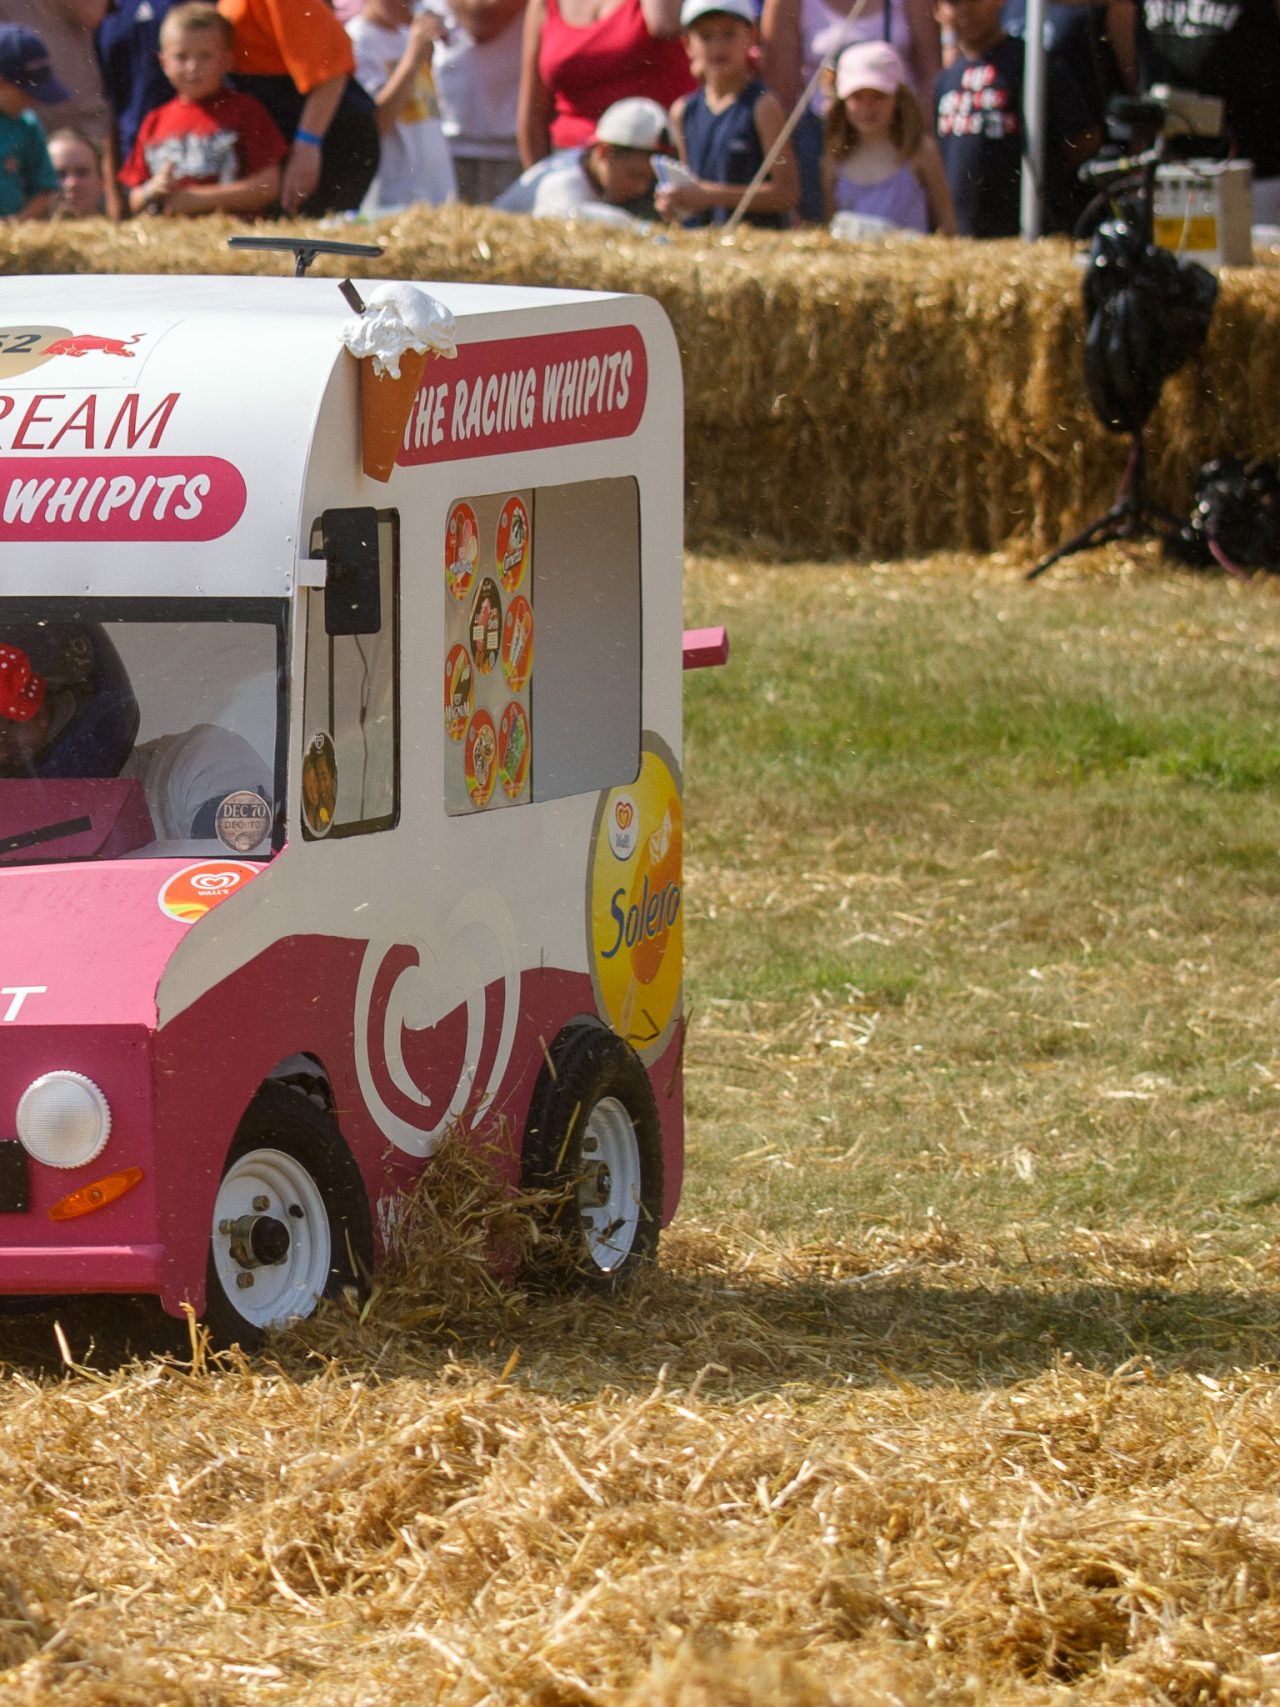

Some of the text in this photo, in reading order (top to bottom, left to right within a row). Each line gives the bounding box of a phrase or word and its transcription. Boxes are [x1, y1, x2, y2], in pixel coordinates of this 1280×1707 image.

[451, 367, 537, 442] RACING
[541, 349, 633, 425] WHIPITS
[2, 473, 212, 525] WHIPITS
[223, 804, 266, 818] DEC 70
[600, 874, 681, 959] Solero
